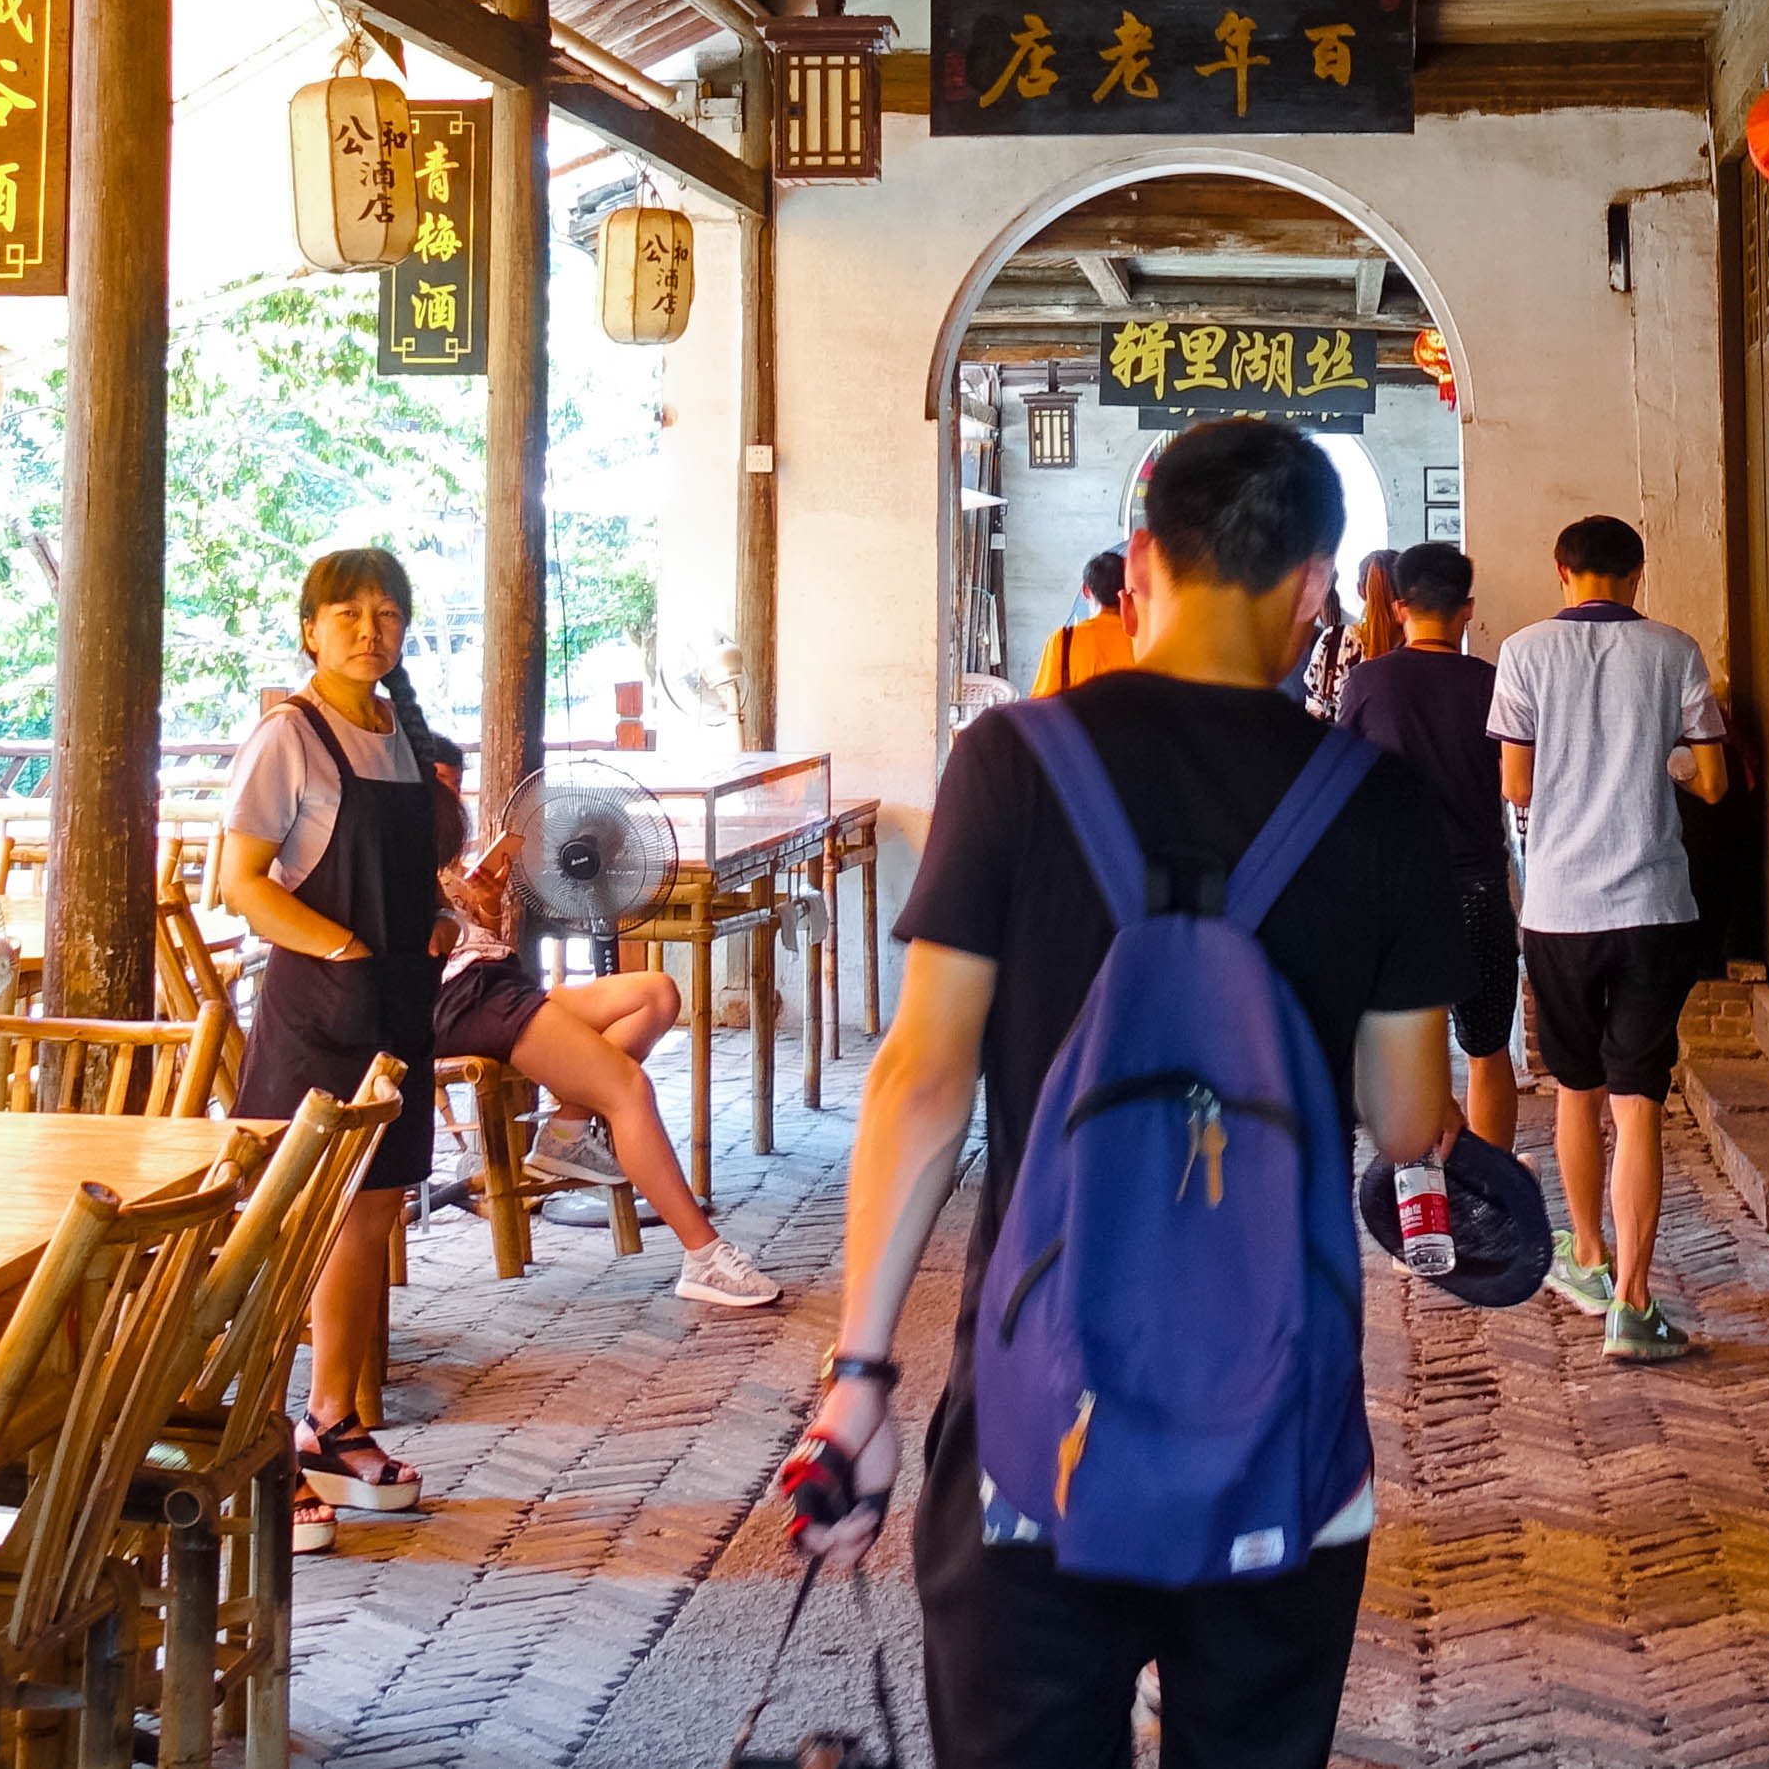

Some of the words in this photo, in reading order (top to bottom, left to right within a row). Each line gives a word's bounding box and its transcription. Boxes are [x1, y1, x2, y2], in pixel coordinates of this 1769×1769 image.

[979, 10, 1355, 117] 百年老店
[411, 141, 463, 333] 青梅酒
[1109, 320, 1368, 401] 辑里湖丝
